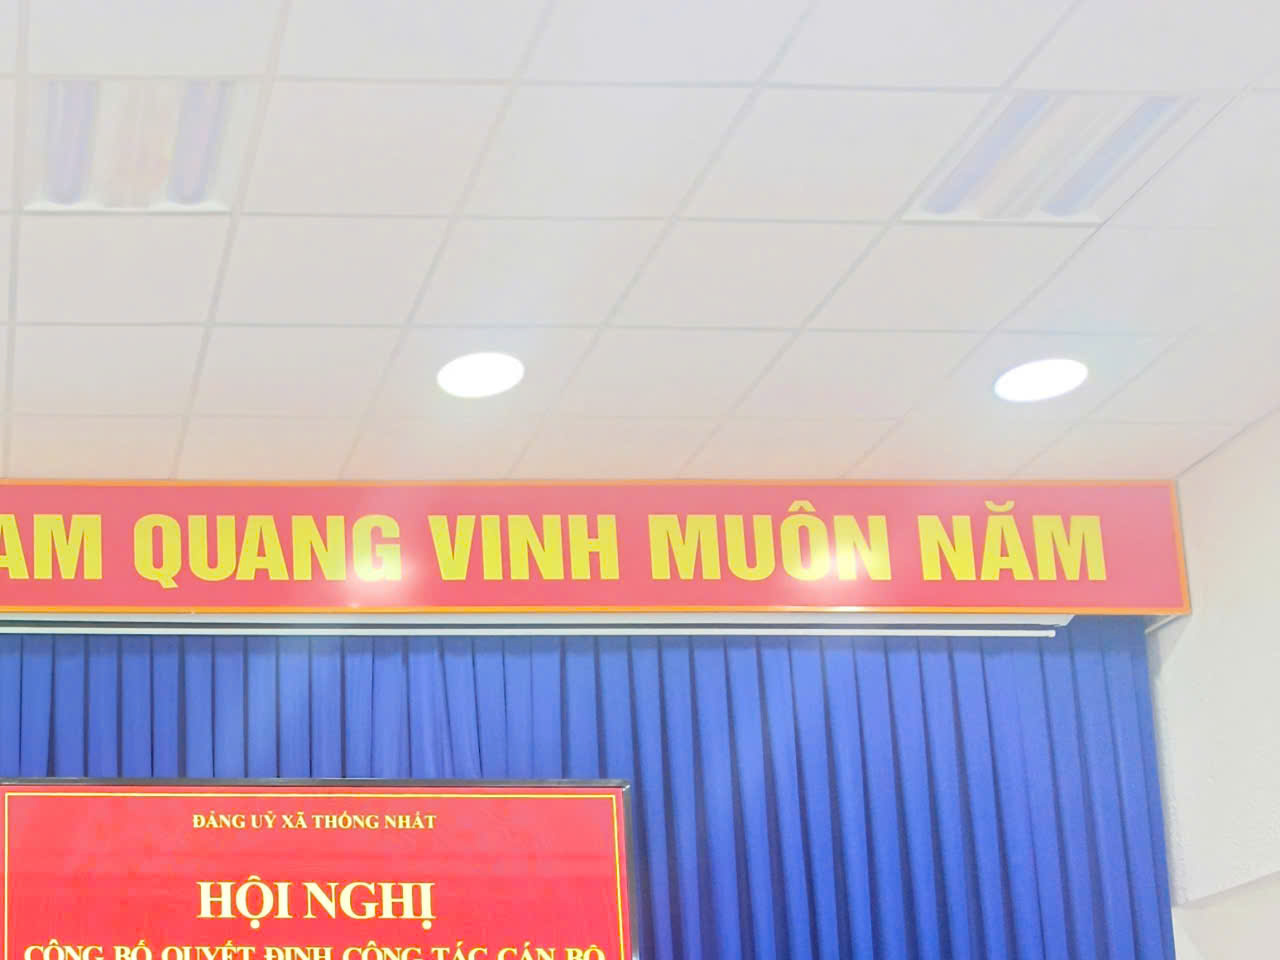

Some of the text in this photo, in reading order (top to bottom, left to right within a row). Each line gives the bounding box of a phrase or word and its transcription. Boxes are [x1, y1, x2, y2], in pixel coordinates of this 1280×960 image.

[133, 513, 402, 589] QUANG
[429, 513, 620, 581] VINH
[649, 501, 891, 582] MUÔN
[918, 500, 1107, 582] NĂM
[192, 810, 246, 829] ĐẢNG
[282, 811, 308, 829] XÃ
[196, 875, 436, 930] HỘI NGHỊ
